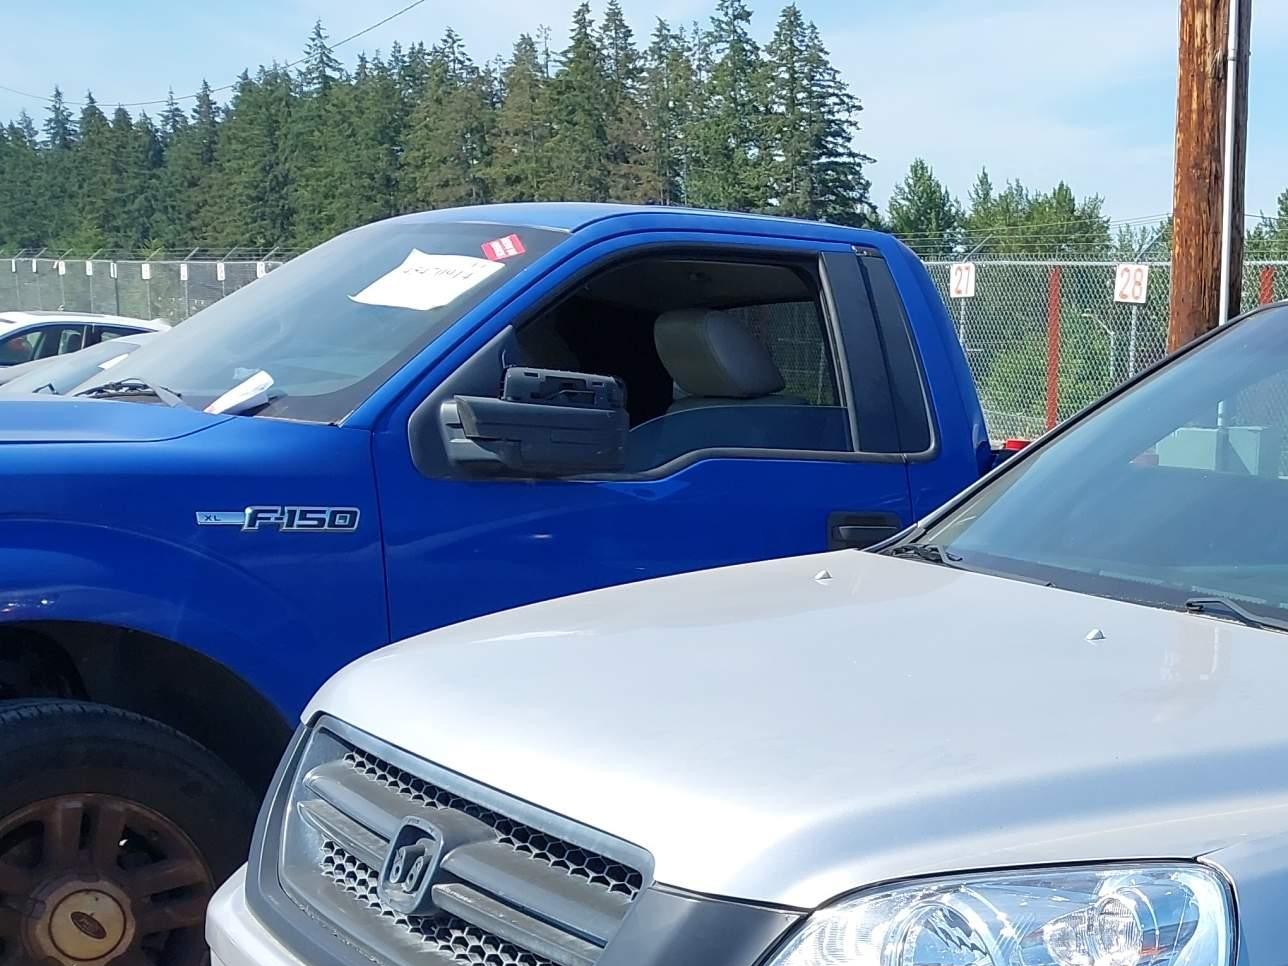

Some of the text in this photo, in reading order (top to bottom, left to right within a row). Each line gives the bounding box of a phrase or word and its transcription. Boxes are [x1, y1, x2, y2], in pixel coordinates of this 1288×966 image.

[954, 265, 971, 295] 27
[1118, 266, 1144, 299] 28
[203, 513, 222, 522] XL
[243, 505, 361, 532] F-150
